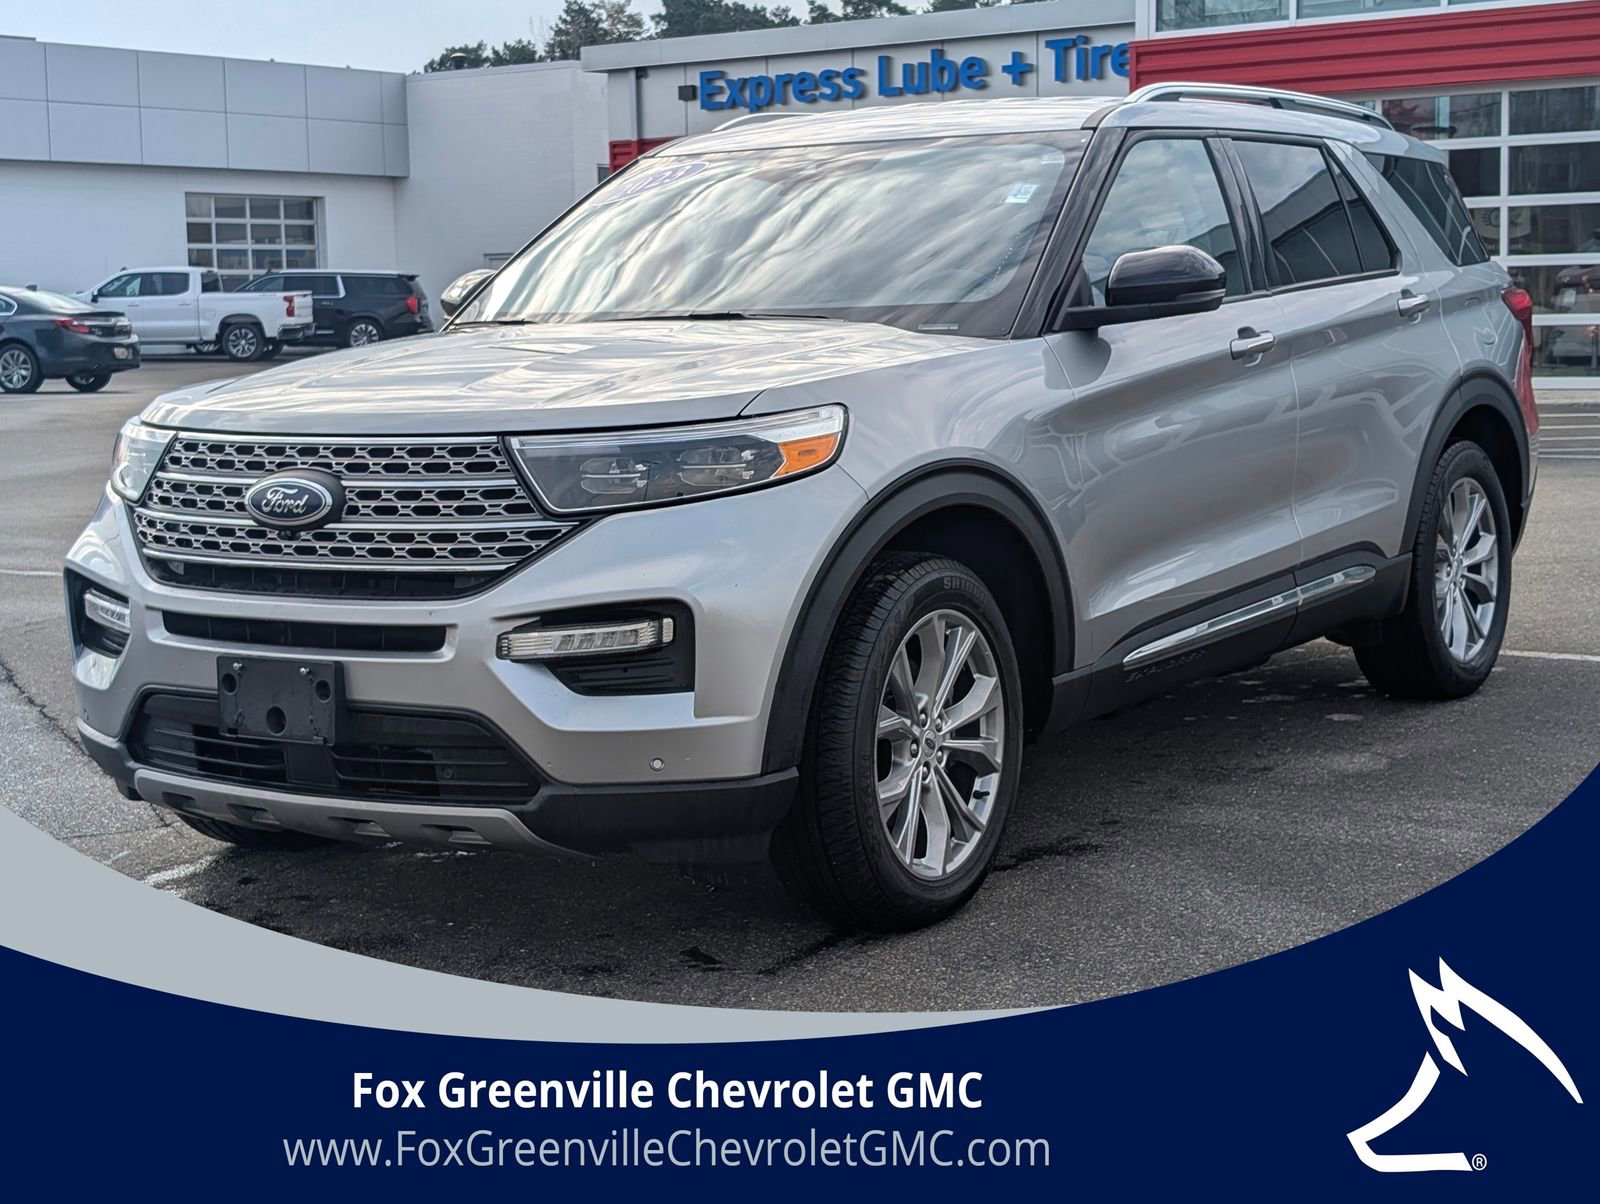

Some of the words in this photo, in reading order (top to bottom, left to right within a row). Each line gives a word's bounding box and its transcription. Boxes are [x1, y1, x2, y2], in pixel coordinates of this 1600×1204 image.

[699, 67, 867, 113] Express
[878, 49, 988, 97] Lube
[1002, 51, 1034, 86] +
[1045, 35, 1130, 83] Tire
[261, 487, 309, 514] Ford
